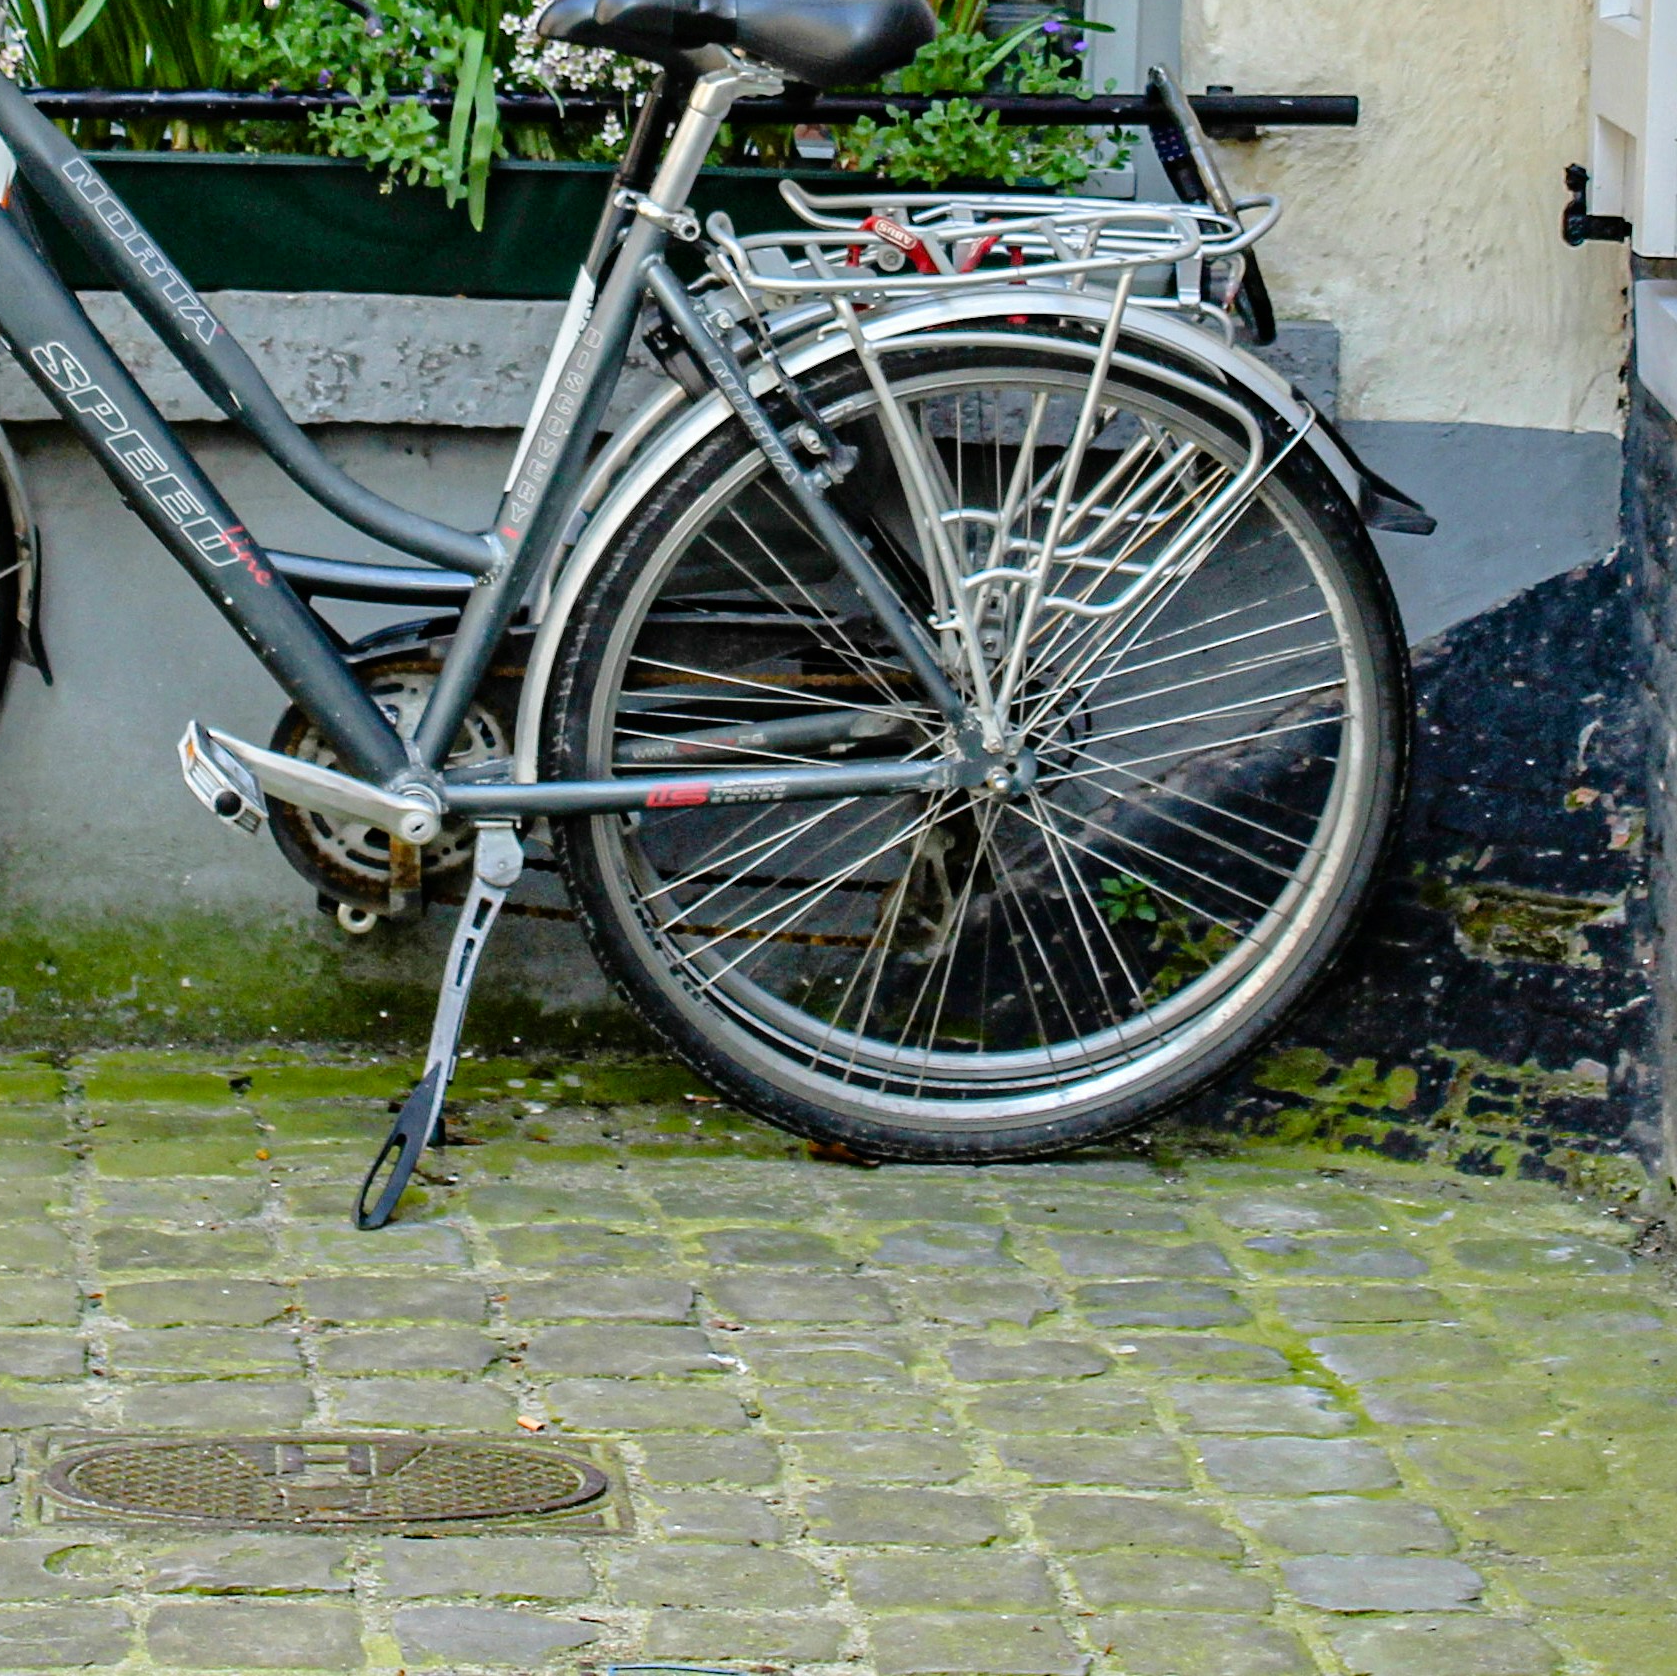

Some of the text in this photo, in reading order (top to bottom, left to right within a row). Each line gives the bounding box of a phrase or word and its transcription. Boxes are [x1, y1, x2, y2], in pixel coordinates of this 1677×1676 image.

[62, 158, 217, 345] NORTA
[877, 222, 914, 245] ABUS
[30, 342, 240, 566] SPEED
[510, 327, 604, 523] DISCOVERY
[706, 358, 799, 485] NORTA
